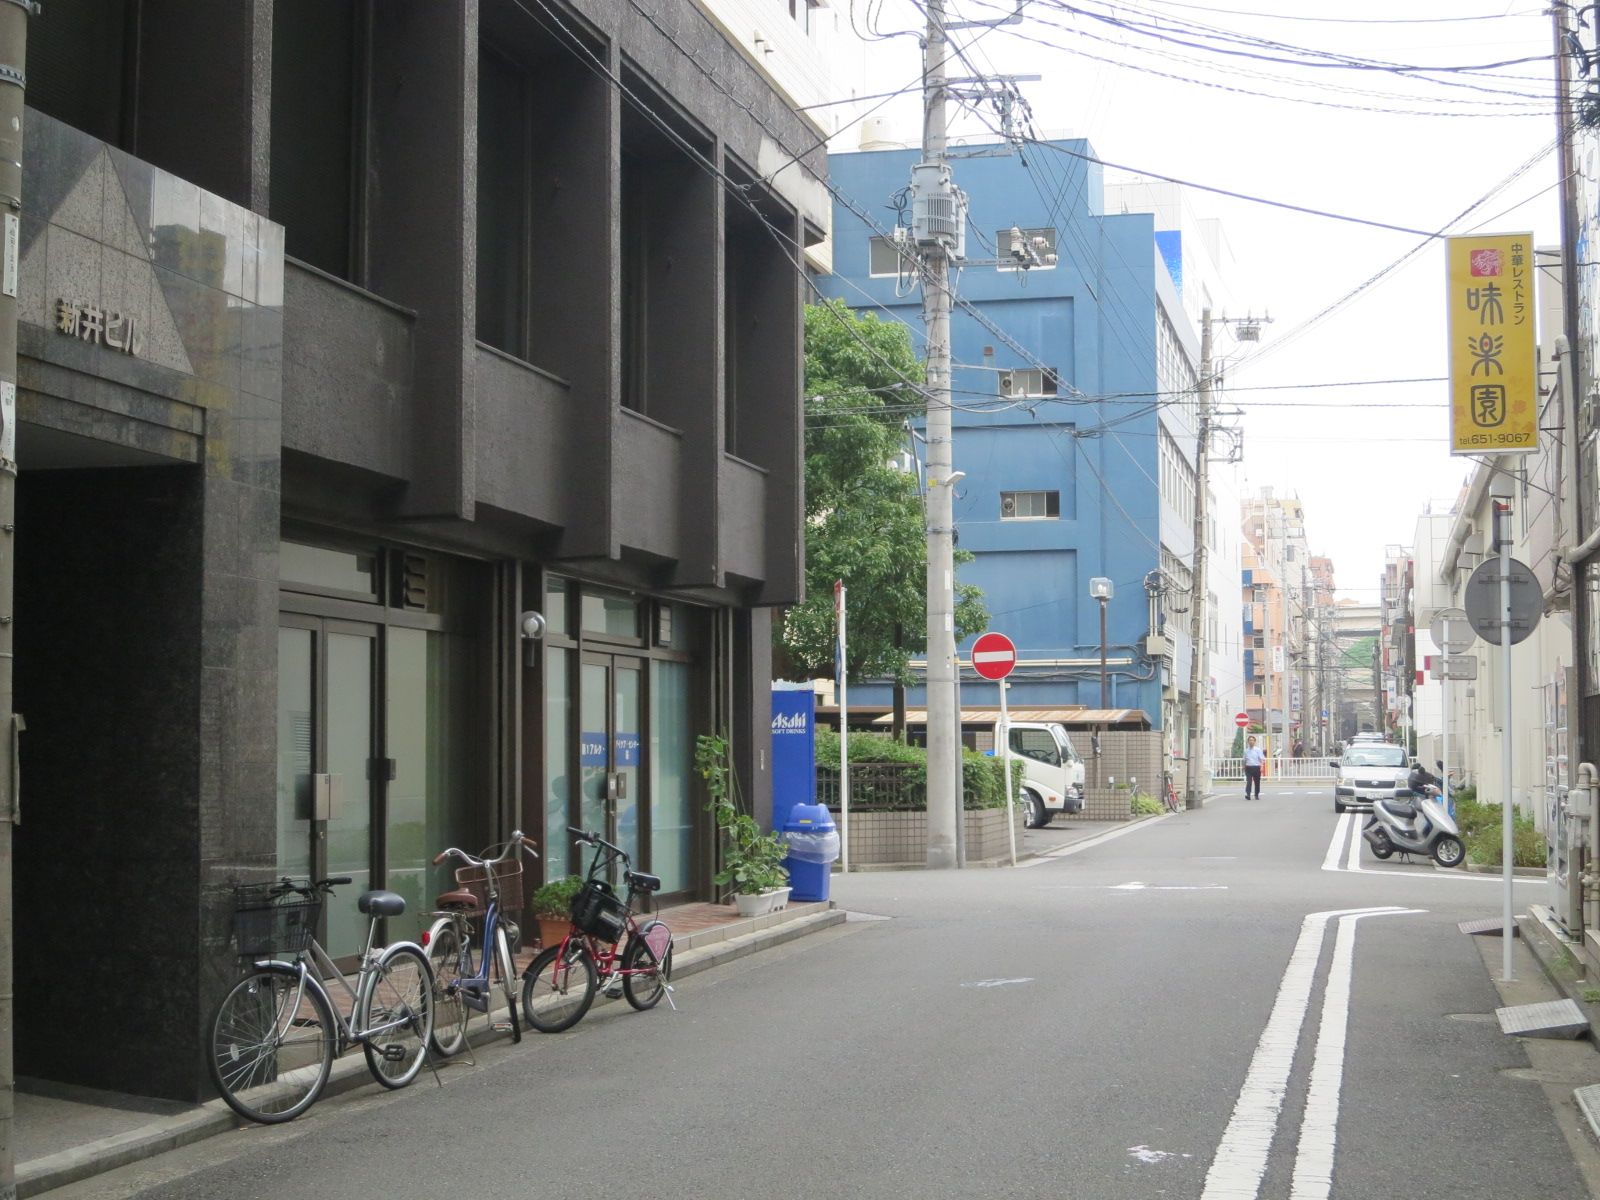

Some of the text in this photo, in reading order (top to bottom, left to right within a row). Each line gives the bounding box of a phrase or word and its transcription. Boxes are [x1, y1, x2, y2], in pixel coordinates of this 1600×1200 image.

[1510, 242, 1526, 326] 中華レストラン
[57, 299, 144, 355] 新井ビル
[1466, 281, 1506, 428] 味楽園
[771, 712, 806, 728] Asahi
